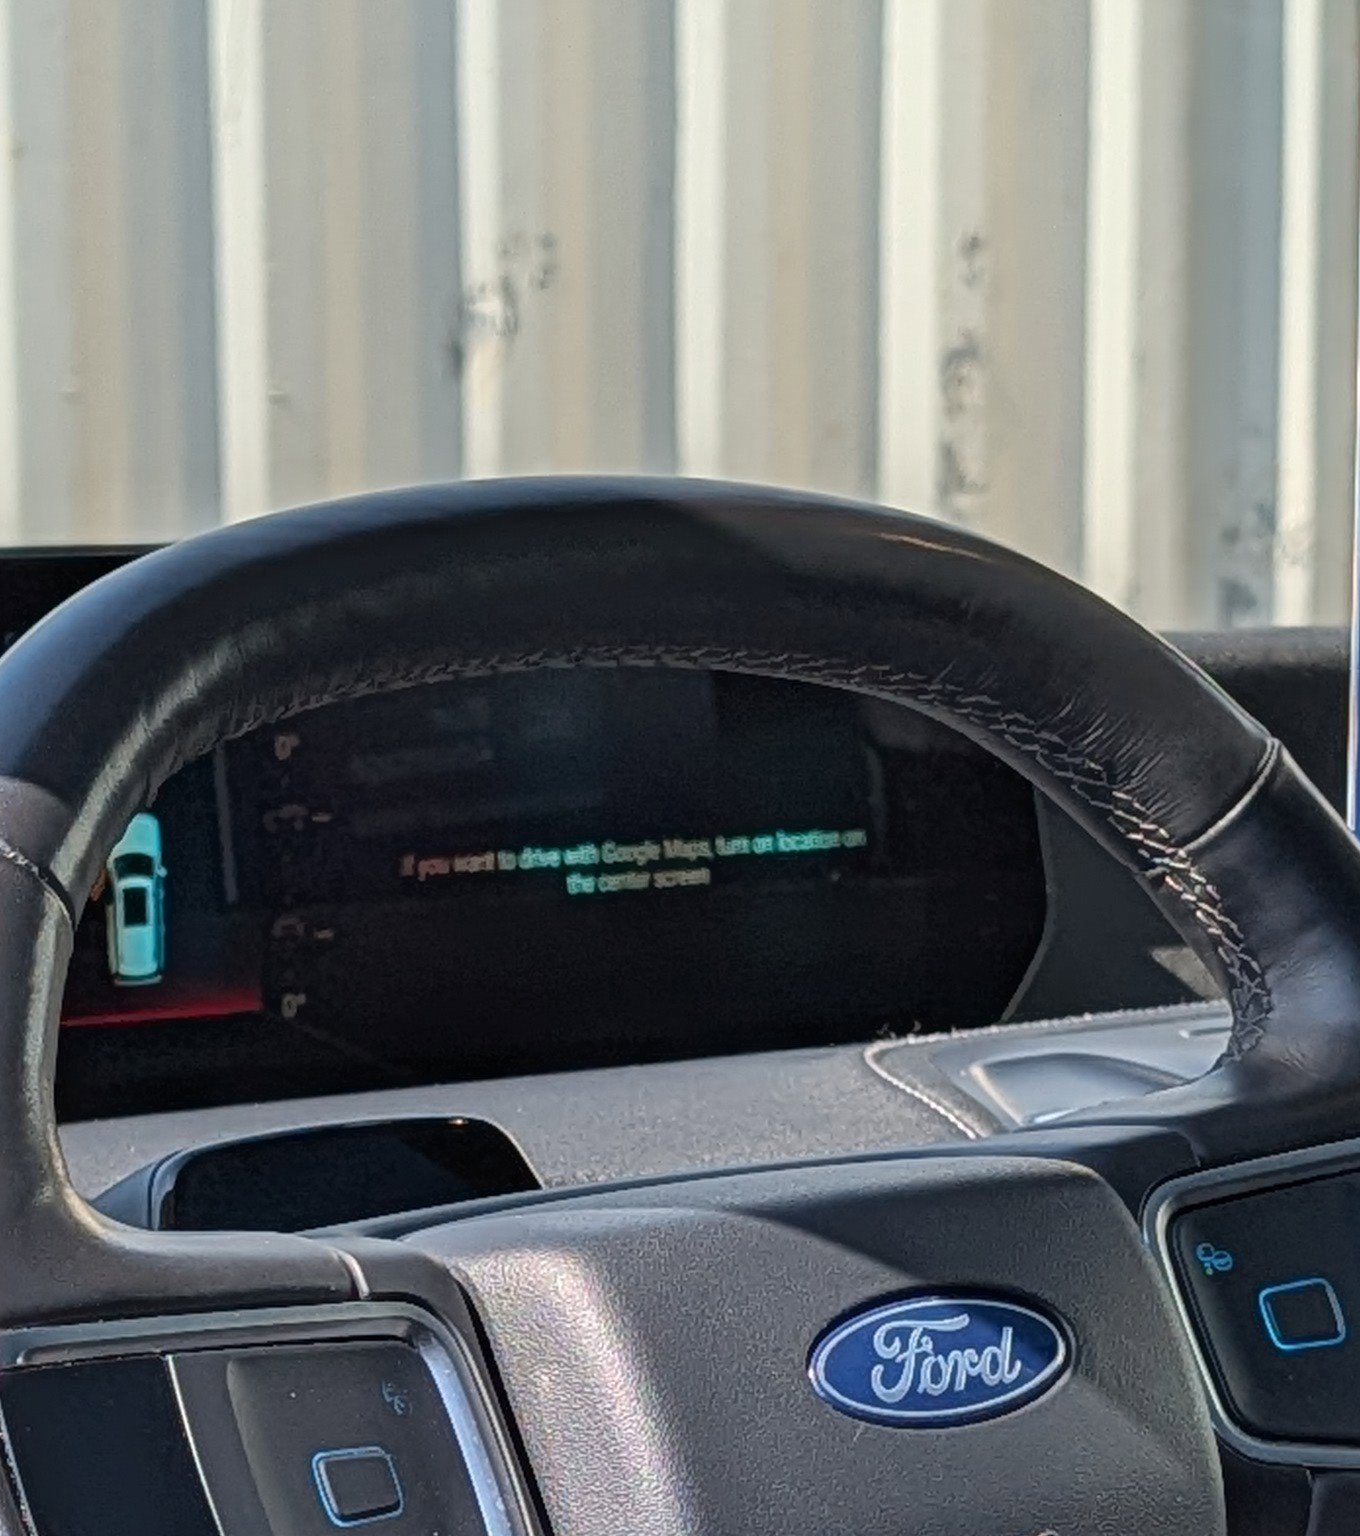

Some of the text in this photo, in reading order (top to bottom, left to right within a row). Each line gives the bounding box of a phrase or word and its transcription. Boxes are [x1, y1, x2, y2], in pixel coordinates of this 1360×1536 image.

[518, 846, 562, 869] drive
[563, 842, 601, 865] with
[601, 839, 661, 866] Google
[775, 828, 841, 851] location
[566, 871, 595, 894] the
[870, 1312, 1022, 1404] Ford
